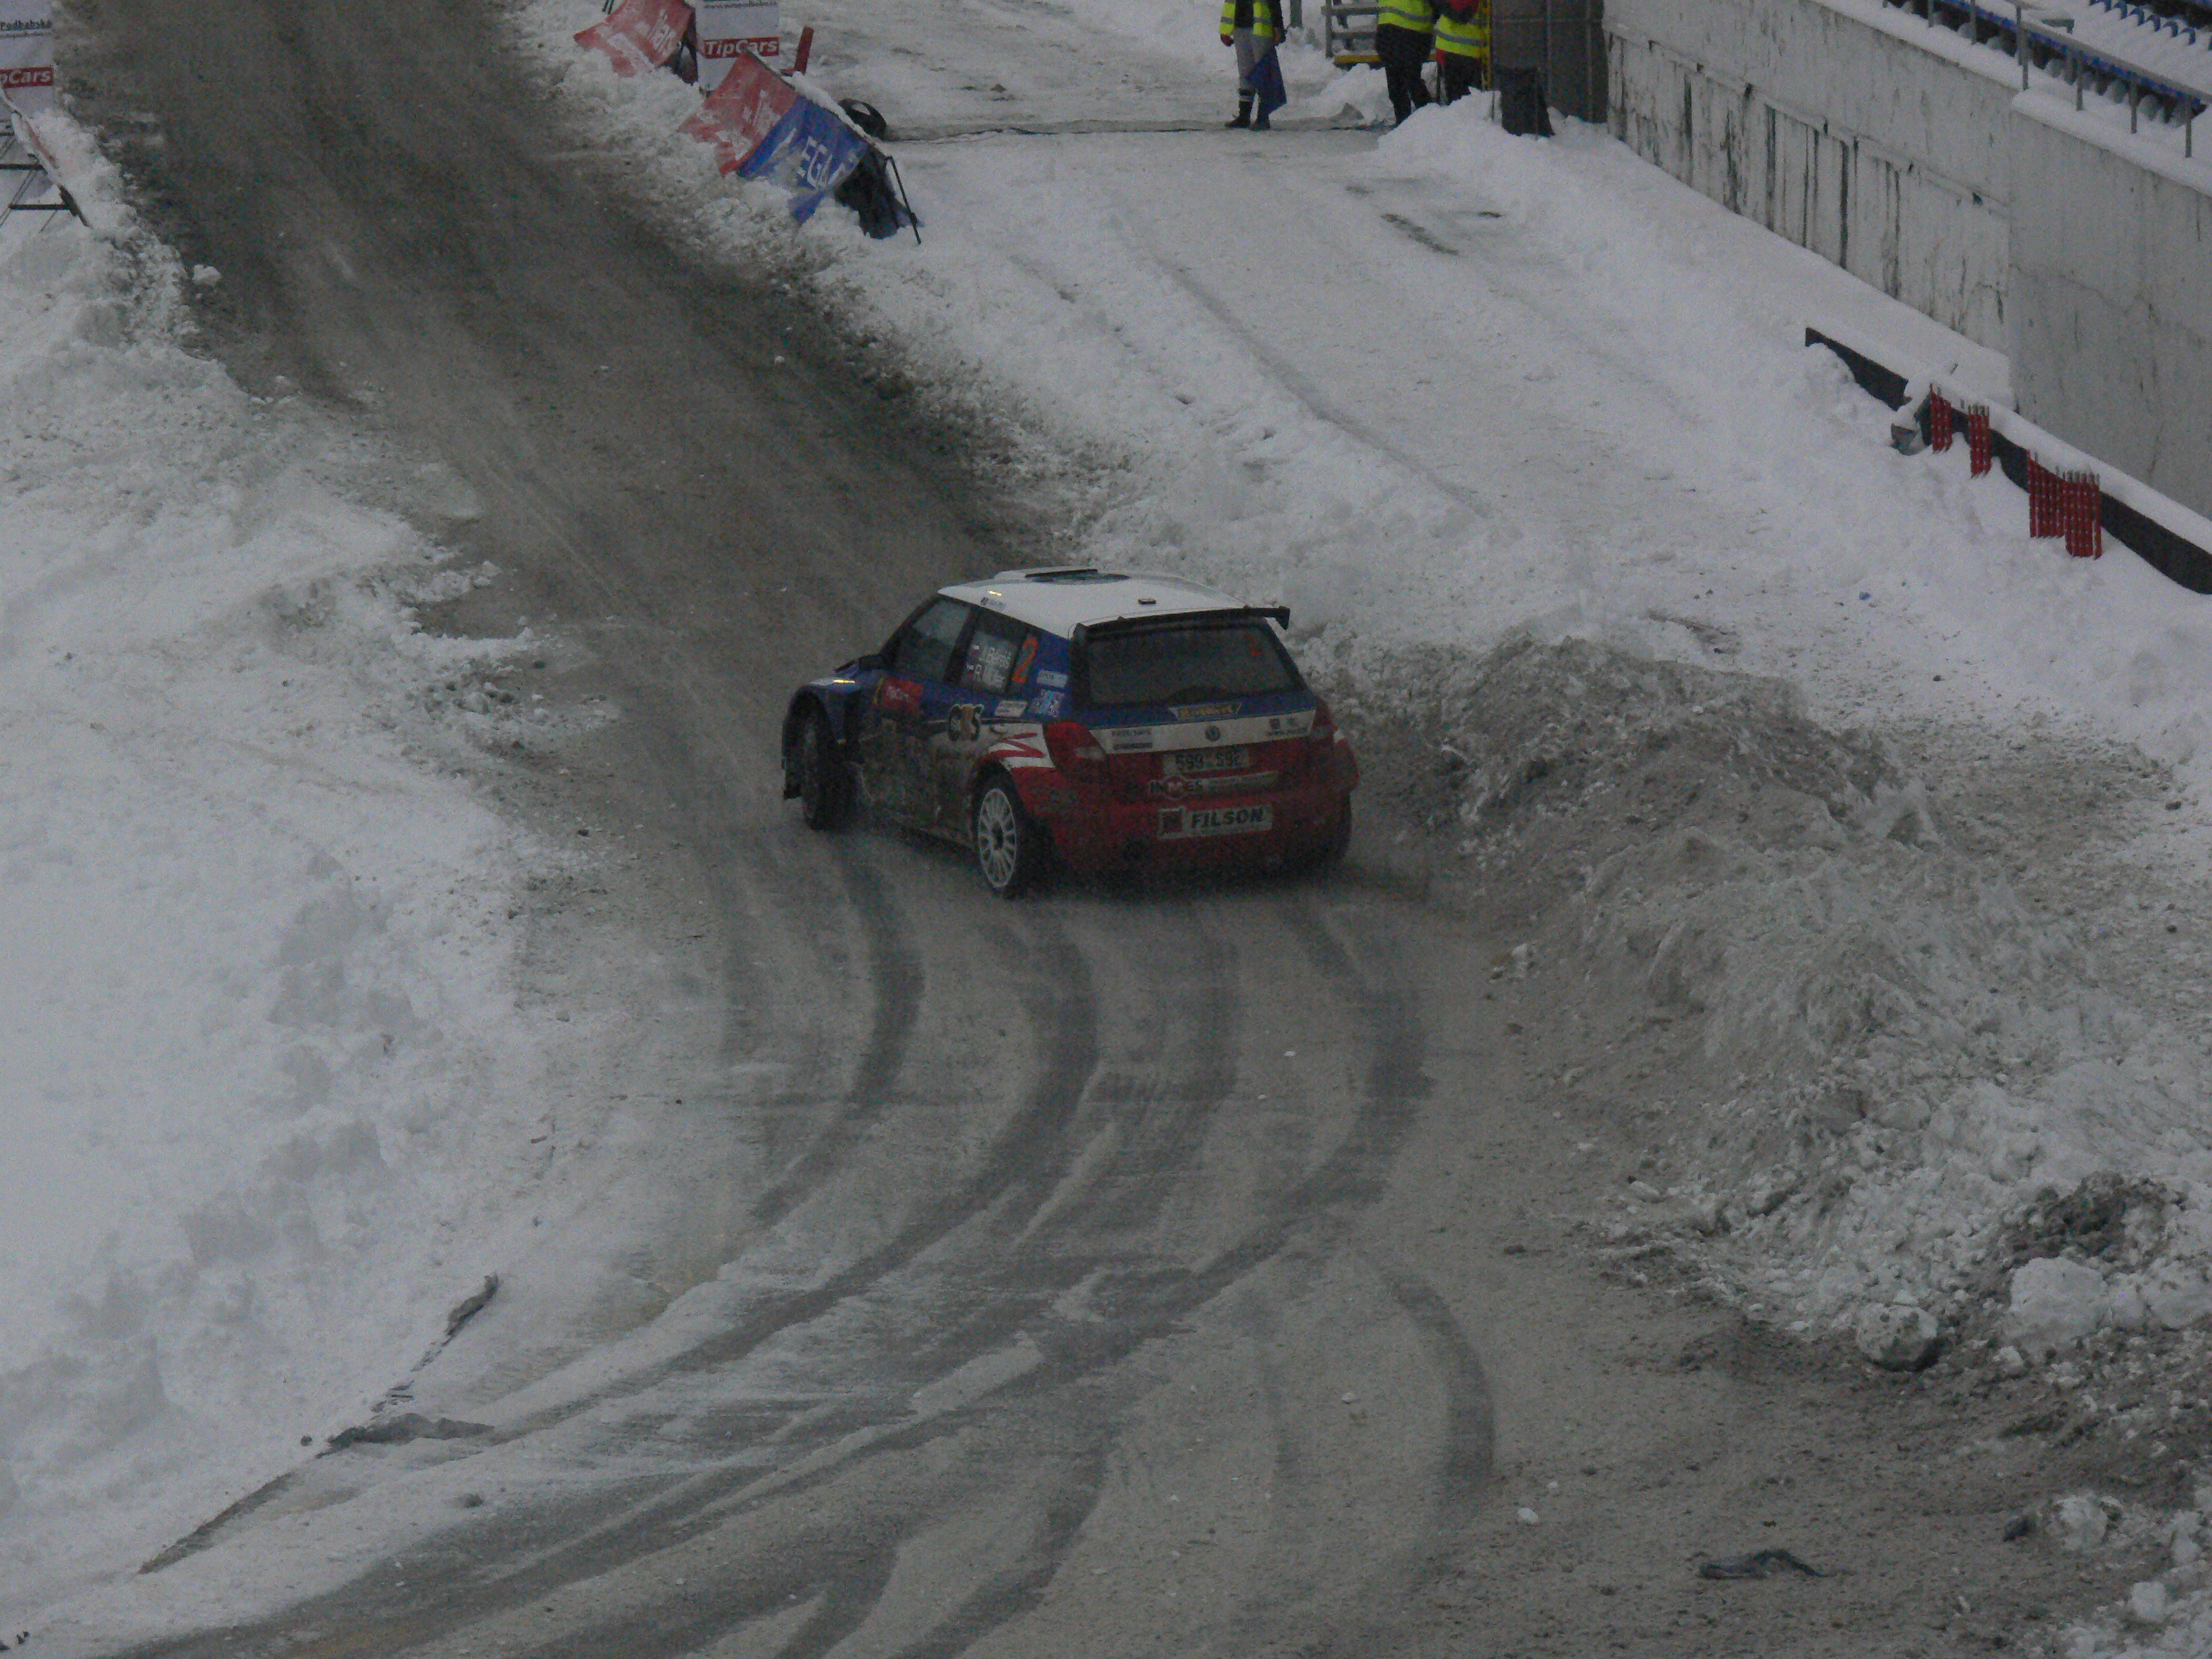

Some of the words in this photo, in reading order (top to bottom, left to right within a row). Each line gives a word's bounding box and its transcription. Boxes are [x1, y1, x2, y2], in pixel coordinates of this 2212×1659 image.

[705, 39, 778, 57] TipCars
[1012, 637, 1038, 684] 2
[1191, 807, 1264, 828] FILSON
